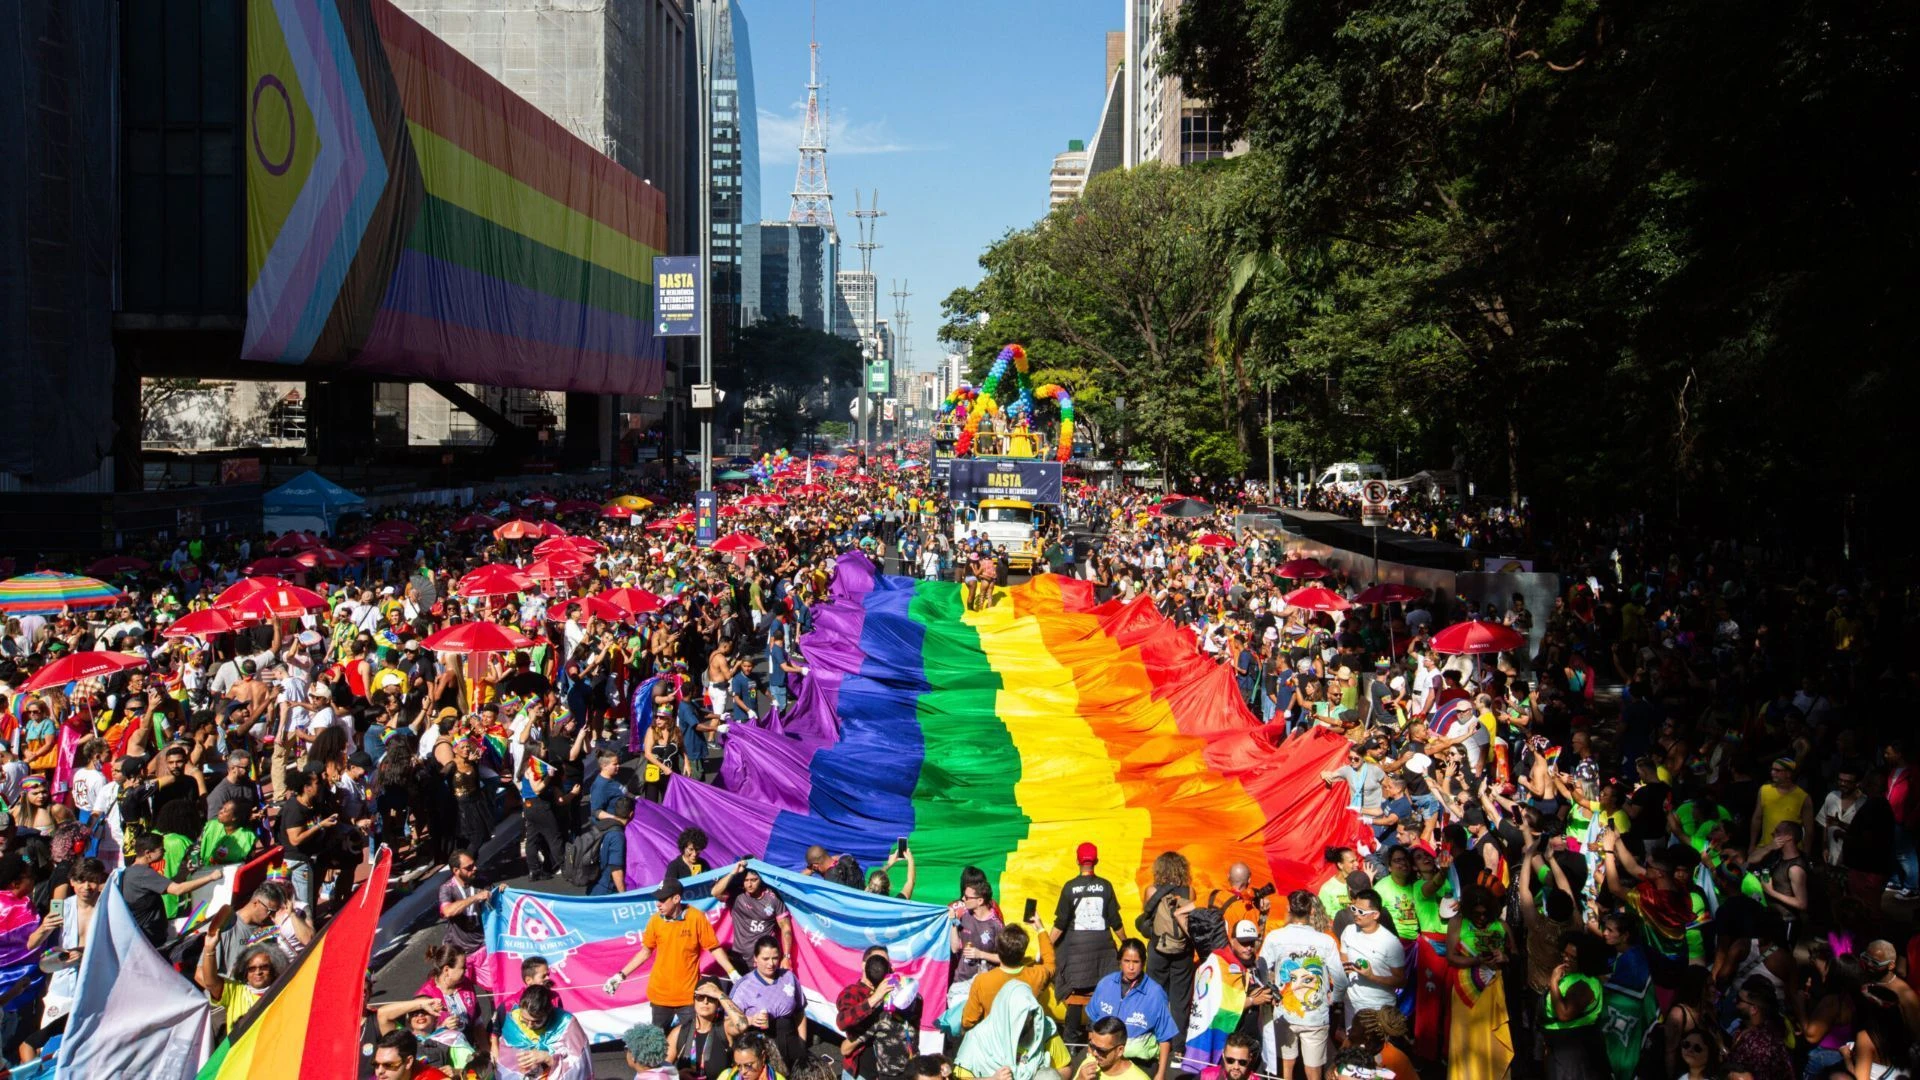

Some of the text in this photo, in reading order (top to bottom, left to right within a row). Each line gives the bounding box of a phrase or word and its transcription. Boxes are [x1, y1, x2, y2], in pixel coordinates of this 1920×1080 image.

[660, 273, 694, 288] BASTA
[988, 473, 1022, 487] BASTA
[81, 664, 108, 674] AMSTEL
[749, 920, 765, 932] 56
